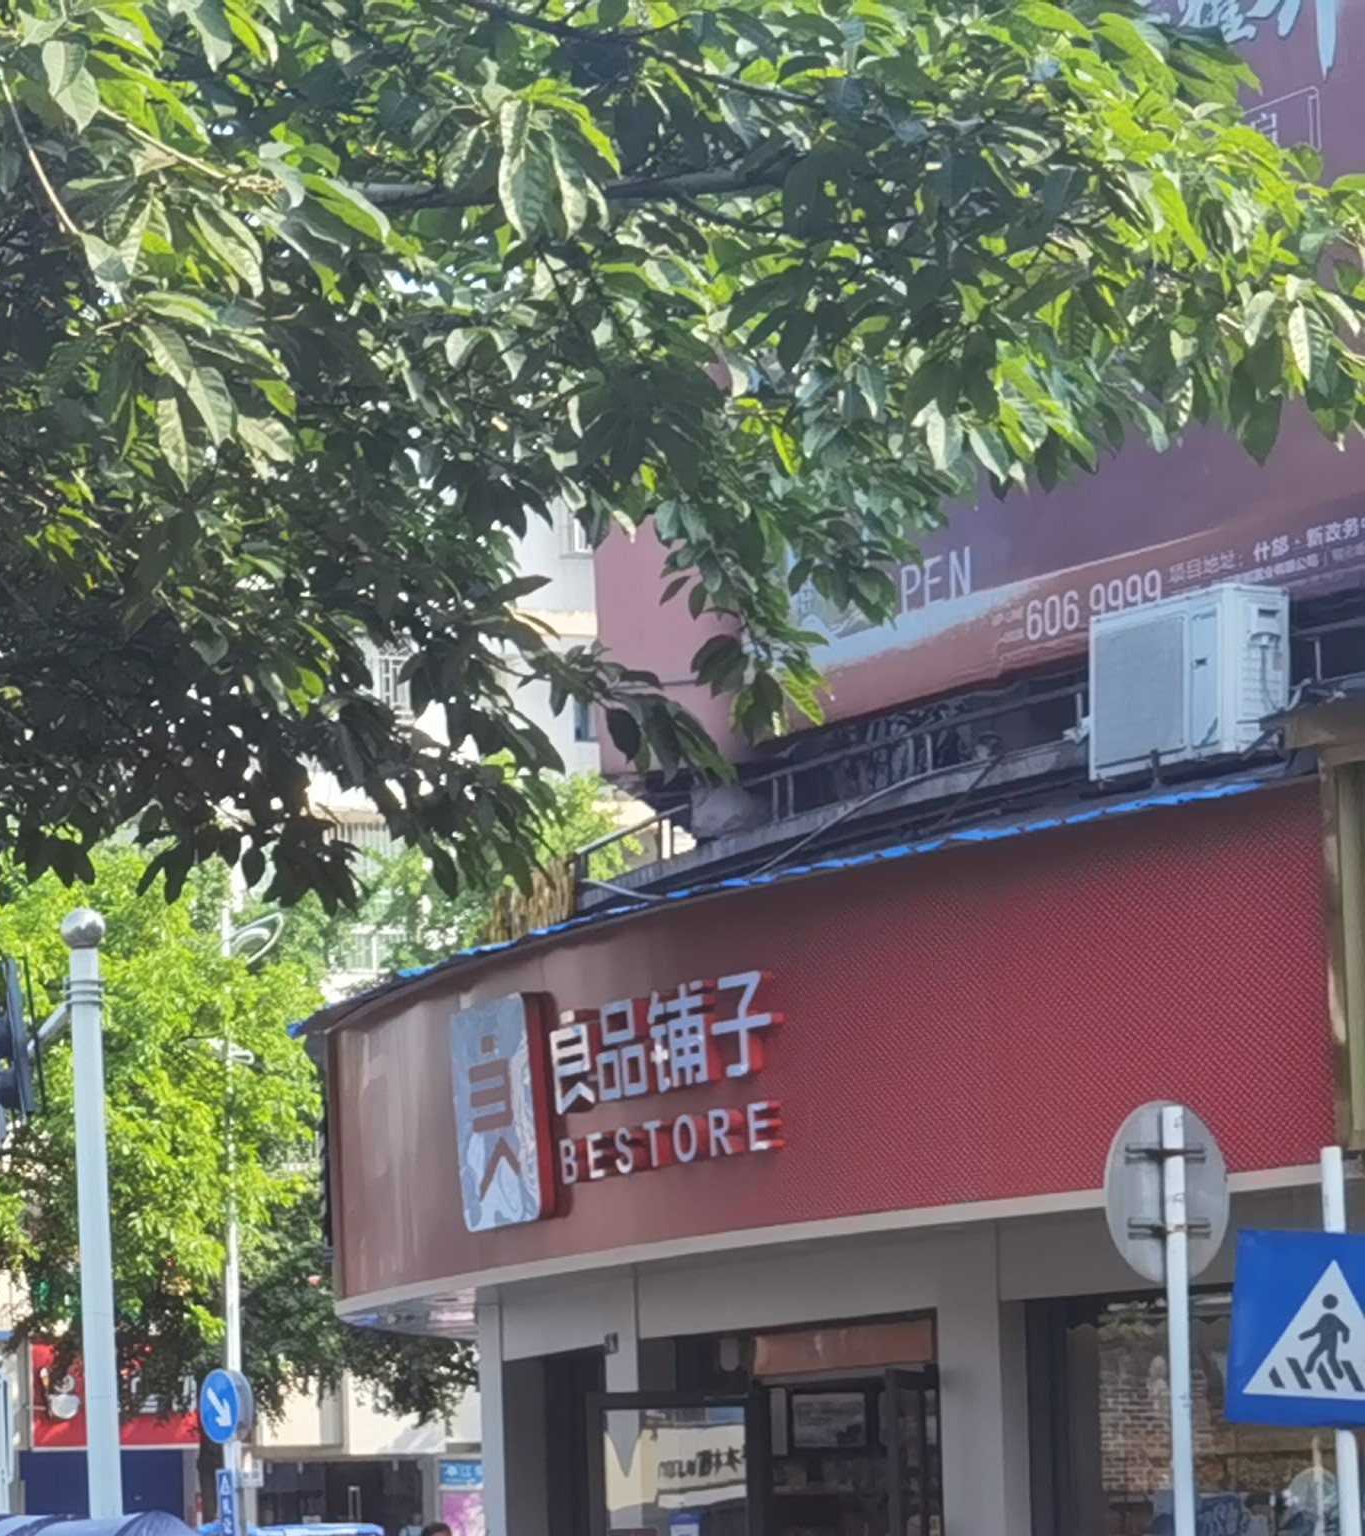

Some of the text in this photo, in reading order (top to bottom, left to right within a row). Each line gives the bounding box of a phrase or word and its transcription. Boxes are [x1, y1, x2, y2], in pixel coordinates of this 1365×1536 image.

[1026, 591, 1079, 641] 606
[1089, 569, 1162, 616] 9999
[549, 970, 773, 1115] 良品铺子
[559, 1101, 772, 1185] BESTORE
